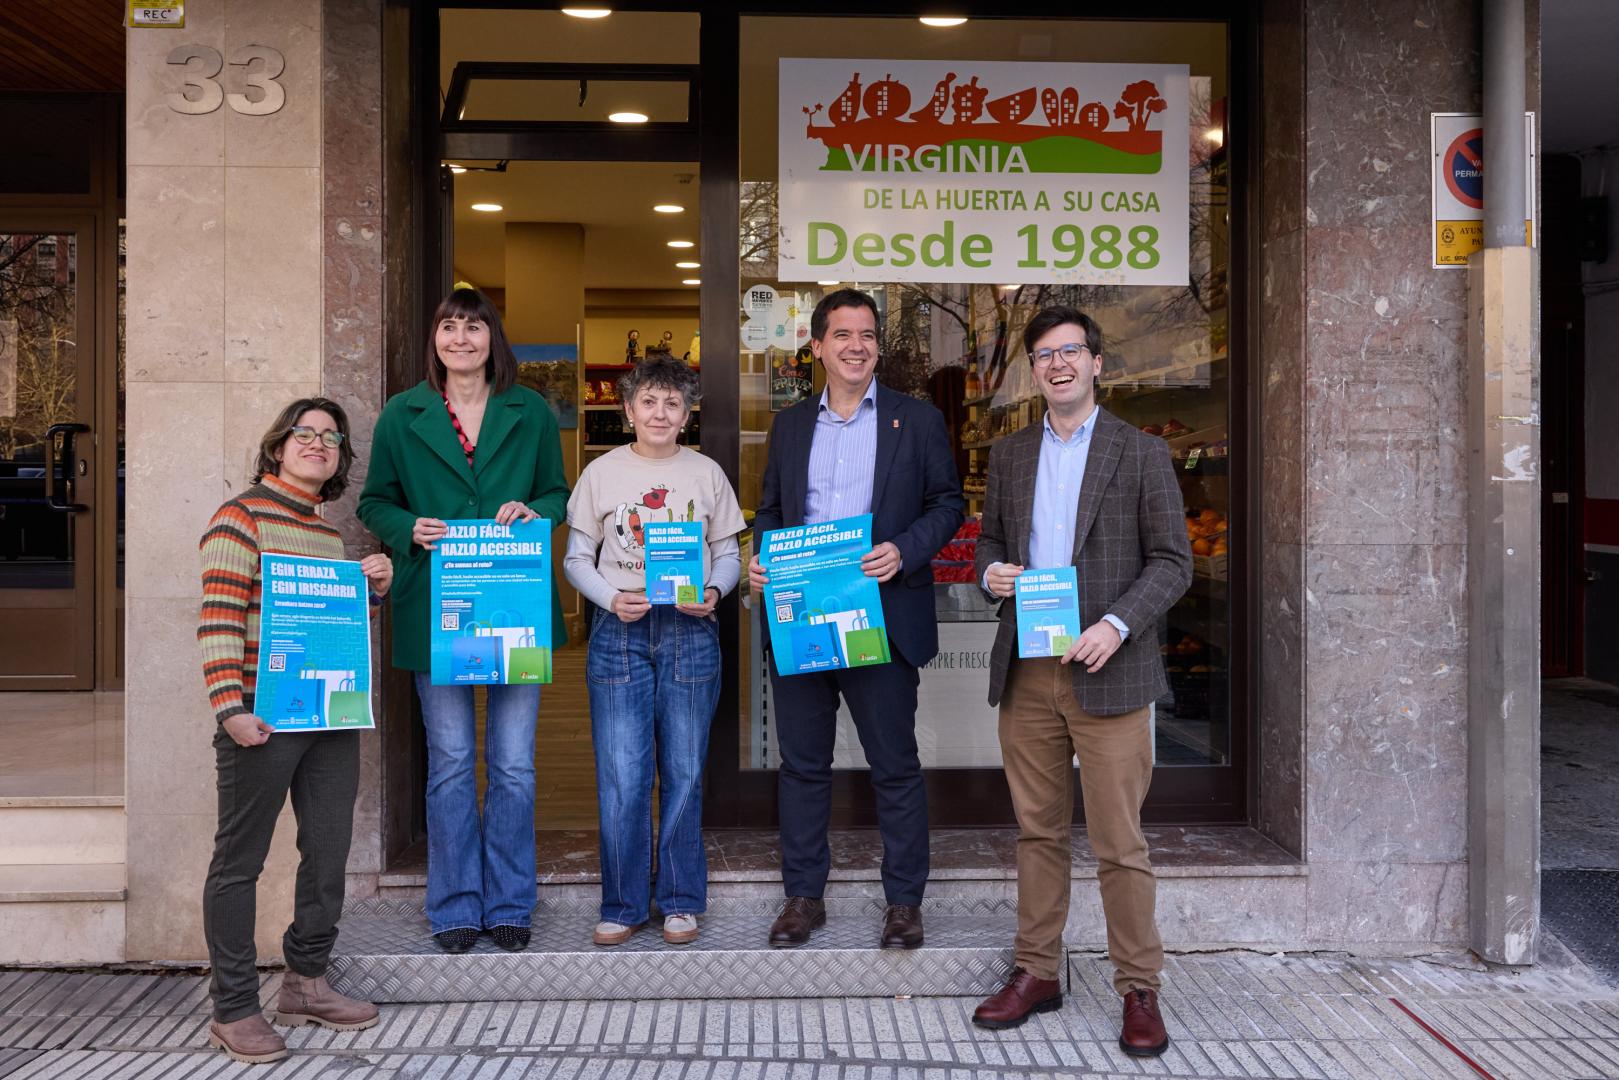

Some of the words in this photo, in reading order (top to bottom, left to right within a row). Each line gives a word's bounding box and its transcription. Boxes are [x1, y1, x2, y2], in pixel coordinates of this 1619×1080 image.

[165, 44, 286, 116] 33
[843, 143, 1031, 173] VIRGINIA
[1455, 170, 1483, 178] PERMA
[863, 188, 893, 210] DE
[901, 188, 929, 210] LA
[937, 189, 1028, 211] HUERTA
[1034, 190, 1051, 212] A
[1063, 190, 1094, 212] SU
[1100, 191, 1161, 213] CASA
[807, 220, 993, 268] Desde
[1017, 223, 1161, 270] 1988
[752, 291, 773, 300] RED
[442, 525, 477, 539] HAZLO
[479, 523, 515, 539] FÁCIL,
[770, 528, 804, 542] HAZLO
[441, 543, 477, 556] HAZLO
[479, 542, 543, 556] ACCESIBLE
[769, 539, 802, 553] HAZLO
[803, 528, 863, 547] ACCESIBLE
[271, 562, 296, 577] EGIN
[297, 564, 339, 581] ERRAZA,
[271, 580, 296, 594] EGIN
[298, 582, 357, 598] IRISGARRIA
[959, 651, 991, 669] FRESC
